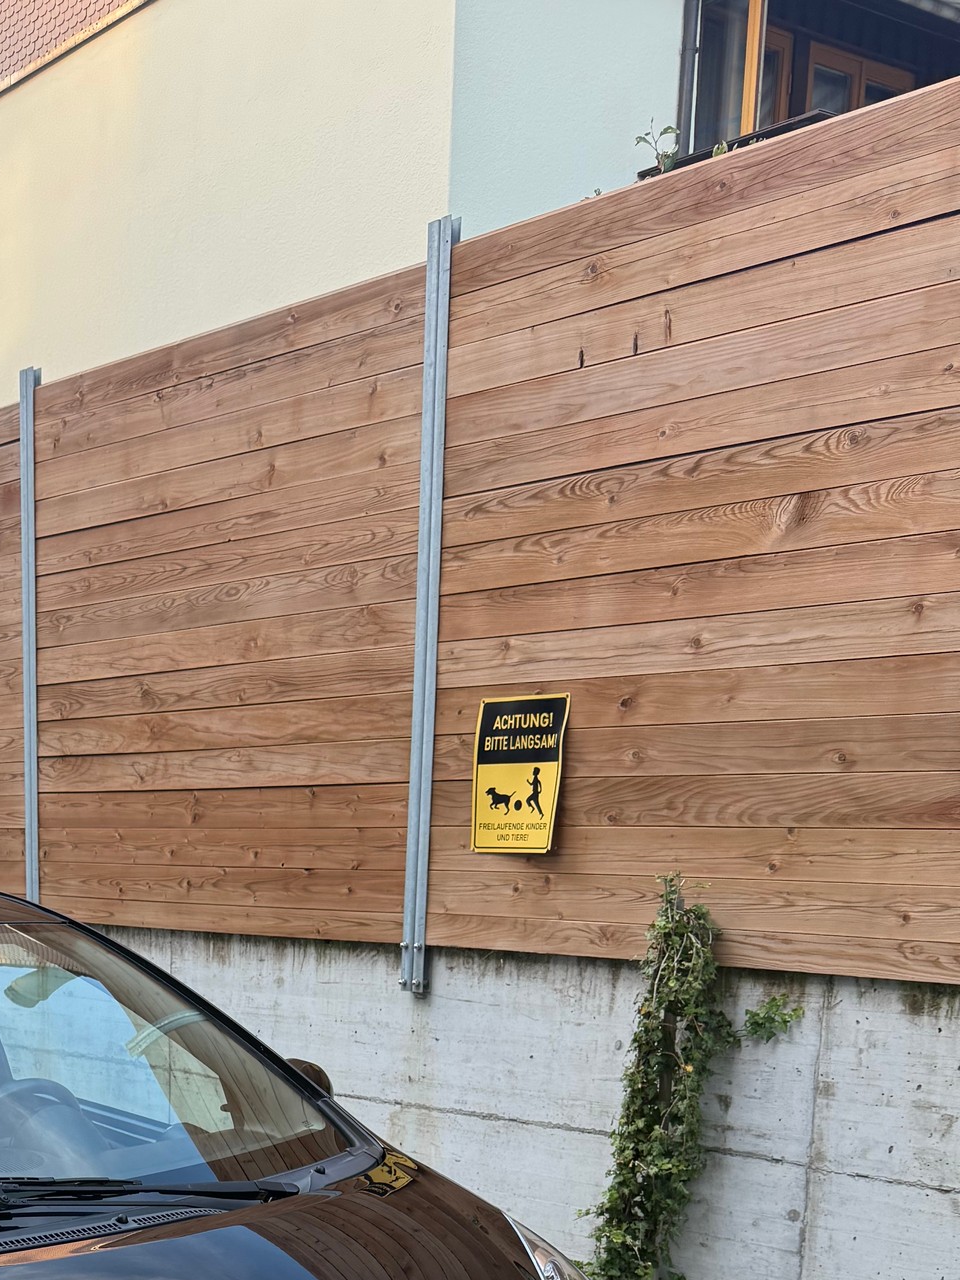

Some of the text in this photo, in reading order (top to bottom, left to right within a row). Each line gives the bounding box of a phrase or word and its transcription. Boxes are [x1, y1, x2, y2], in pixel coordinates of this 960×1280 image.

[493, 712, 553, 730] ACHTUNG!
[484, 733, 557, 751] BITTE LANGSAM!
[478, 822, 547, 831] FREILAUFENDE KINDER
[496, 834, 510, 842] UND
